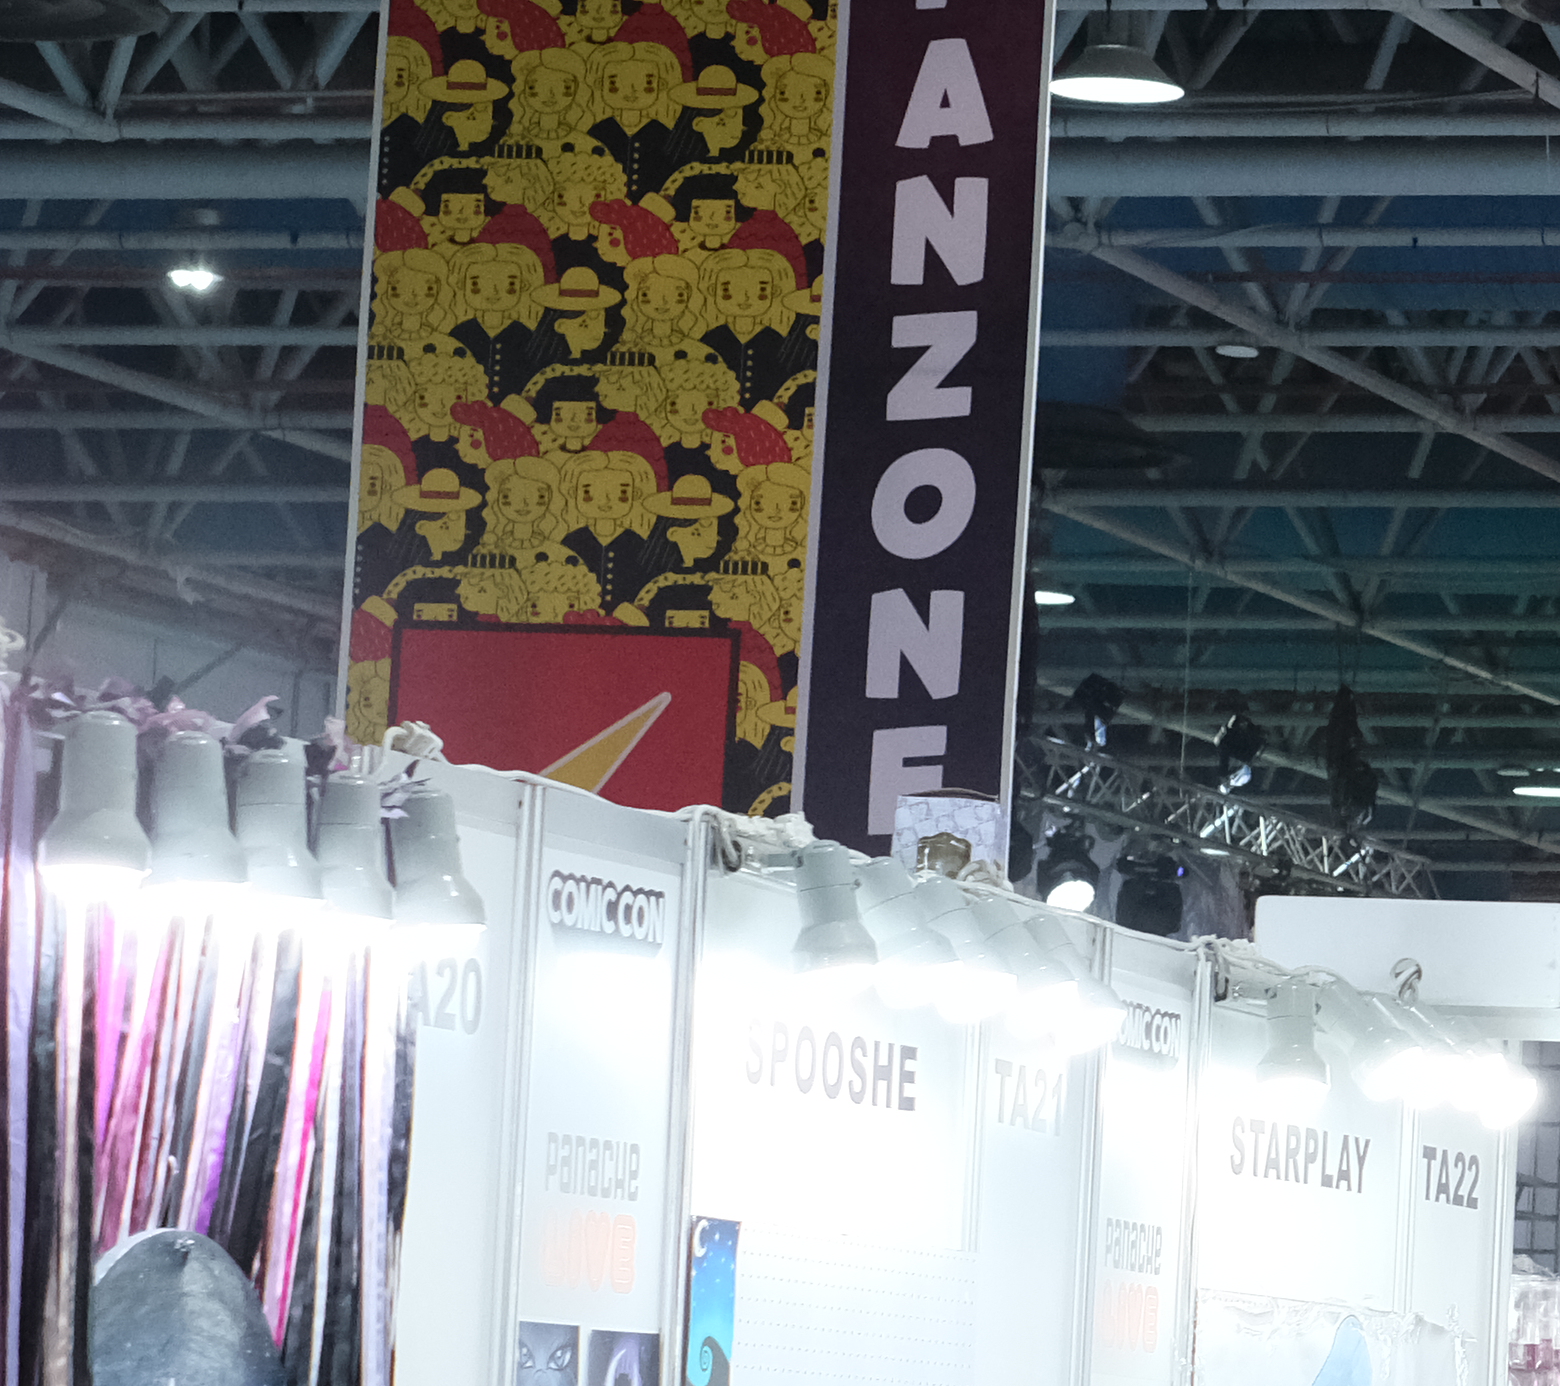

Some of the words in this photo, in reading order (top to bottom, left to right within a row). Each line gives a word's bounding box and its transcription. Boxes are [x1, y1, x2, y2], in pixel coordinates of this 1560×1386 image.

[549, 869, 617, 935] COMIC
[617, 883, 665, 945] CON
[745, 1017, 919, 1112] SPOOSHE
[1229, 1115, 1371, 1194] STARPLAY
[1422, 1144, 1481, 1210] TA22
